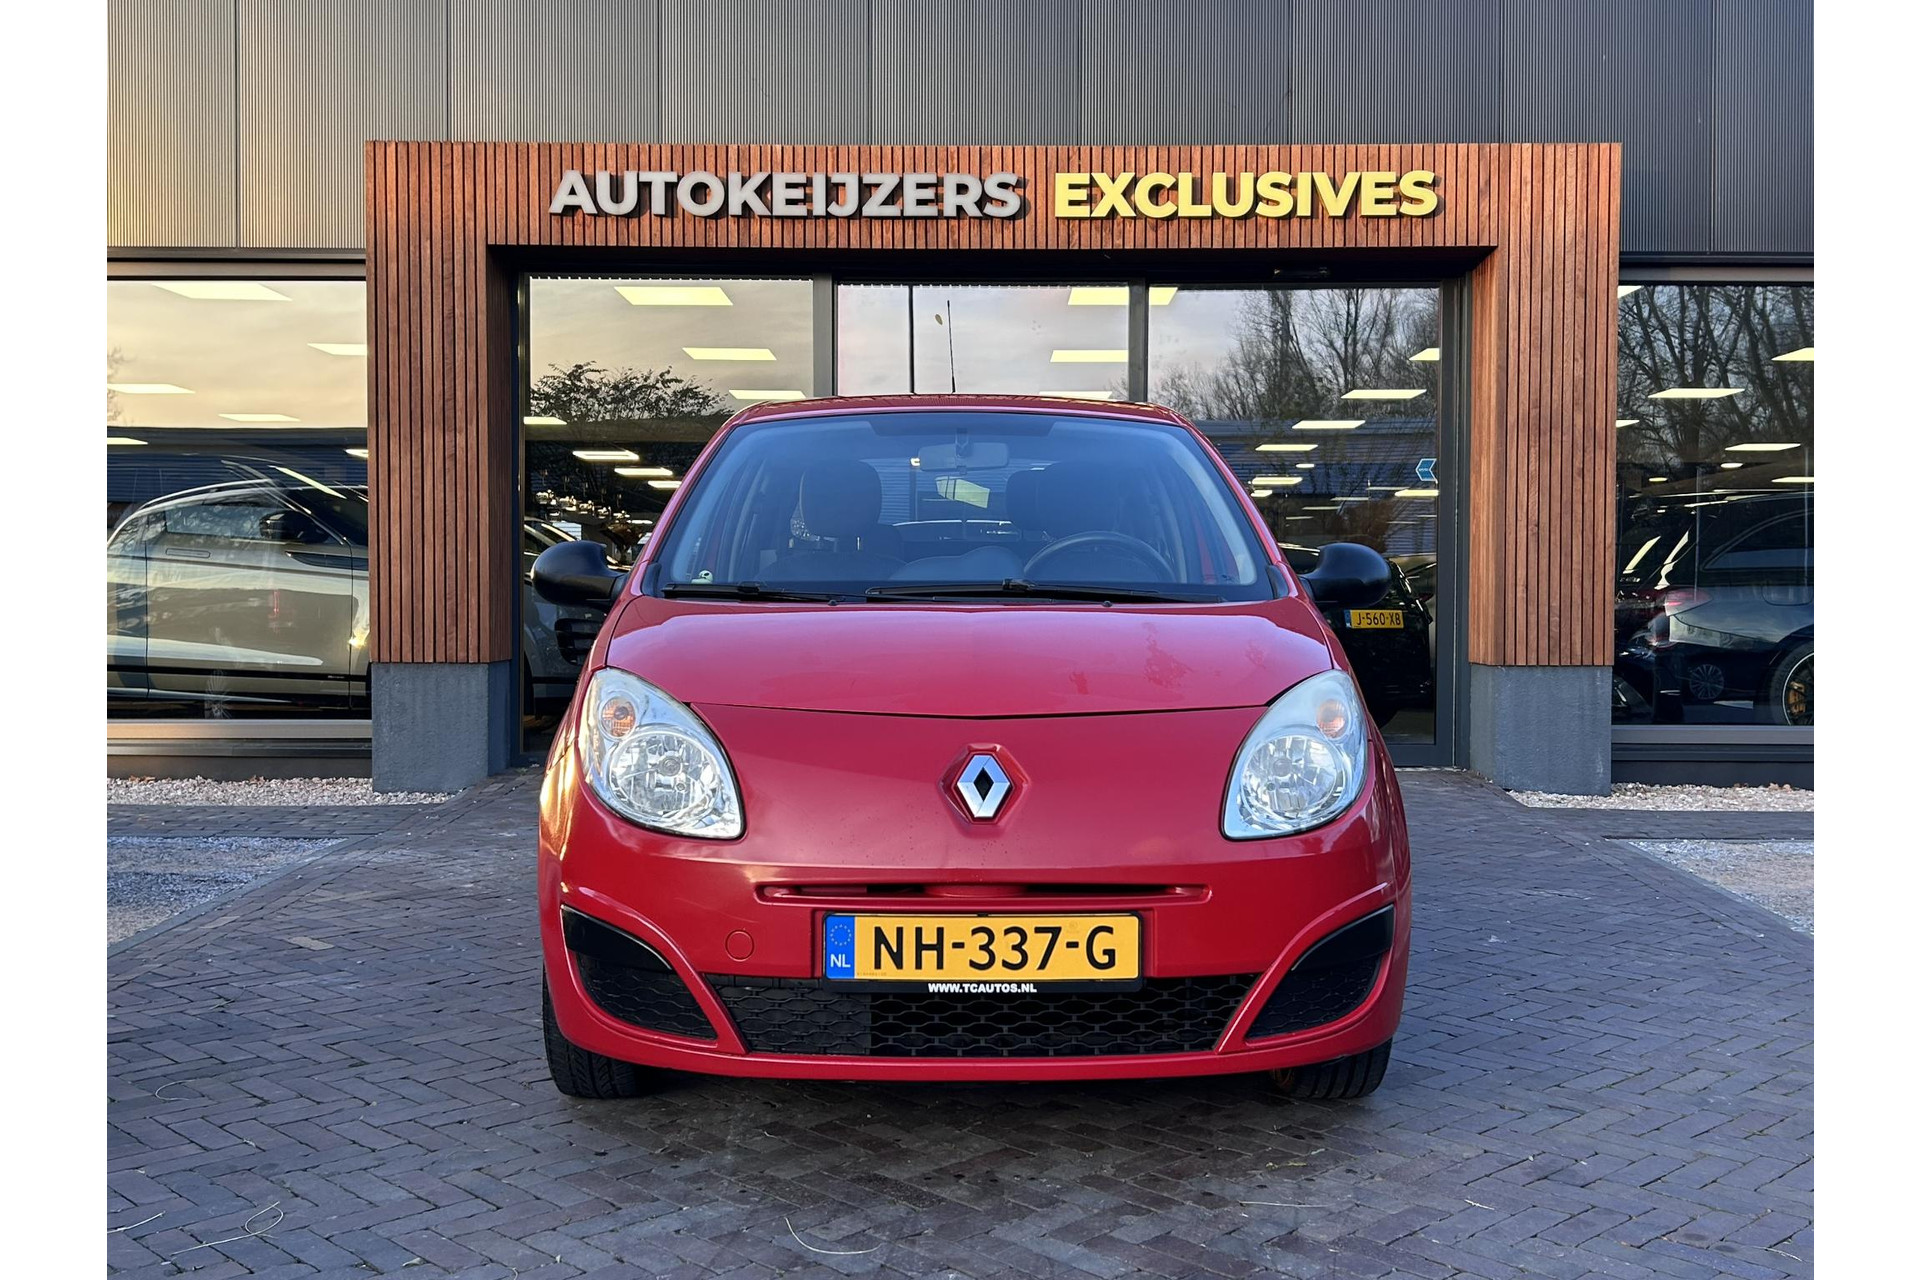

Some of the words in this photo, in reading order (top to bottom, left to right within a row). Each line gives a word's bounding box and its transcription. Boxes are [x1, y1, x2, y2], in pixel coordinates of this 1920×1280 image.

[549, 170, 1022, 219] AUTOKEIJZERS
[1055, 170, 1440, 219] EXCLUSIVES
[1357, 612, 1401, 626] J-560-XB
[873, 926, 1117, 971] NH-337-G
[830, 954, 851, 968] NL
[928, 983, 1037, 993] WWW.TCAUTOS.NL
